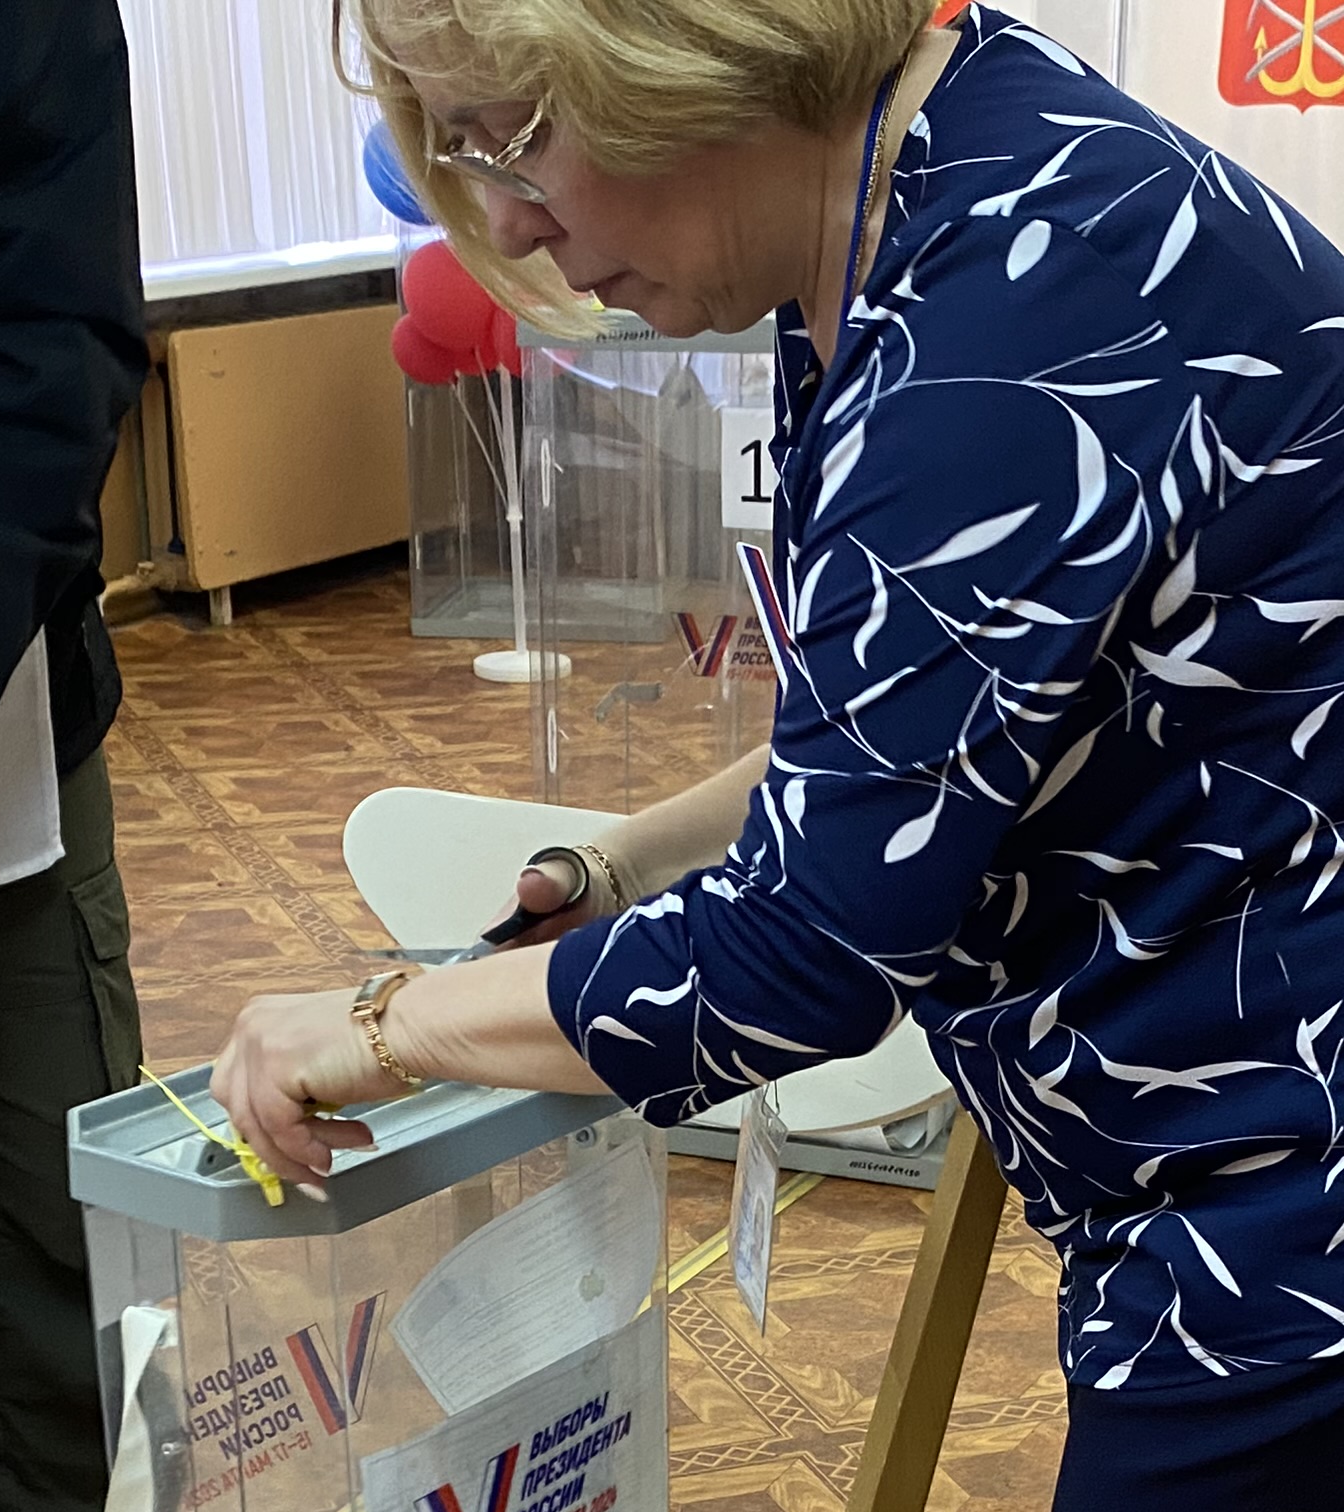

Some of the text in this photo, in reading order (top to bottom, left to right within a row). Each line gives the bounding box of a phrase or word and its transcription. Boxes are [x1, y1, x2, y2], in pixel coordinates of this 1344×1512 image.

[740, 439, 772, 503] 1
[731, 651, 774, 667] РОССИ
[521, 1410, 632, 1501] ПРЕЗИДЕНТА
[529, 1390, 610, 1461] ВЫБОРЫ
